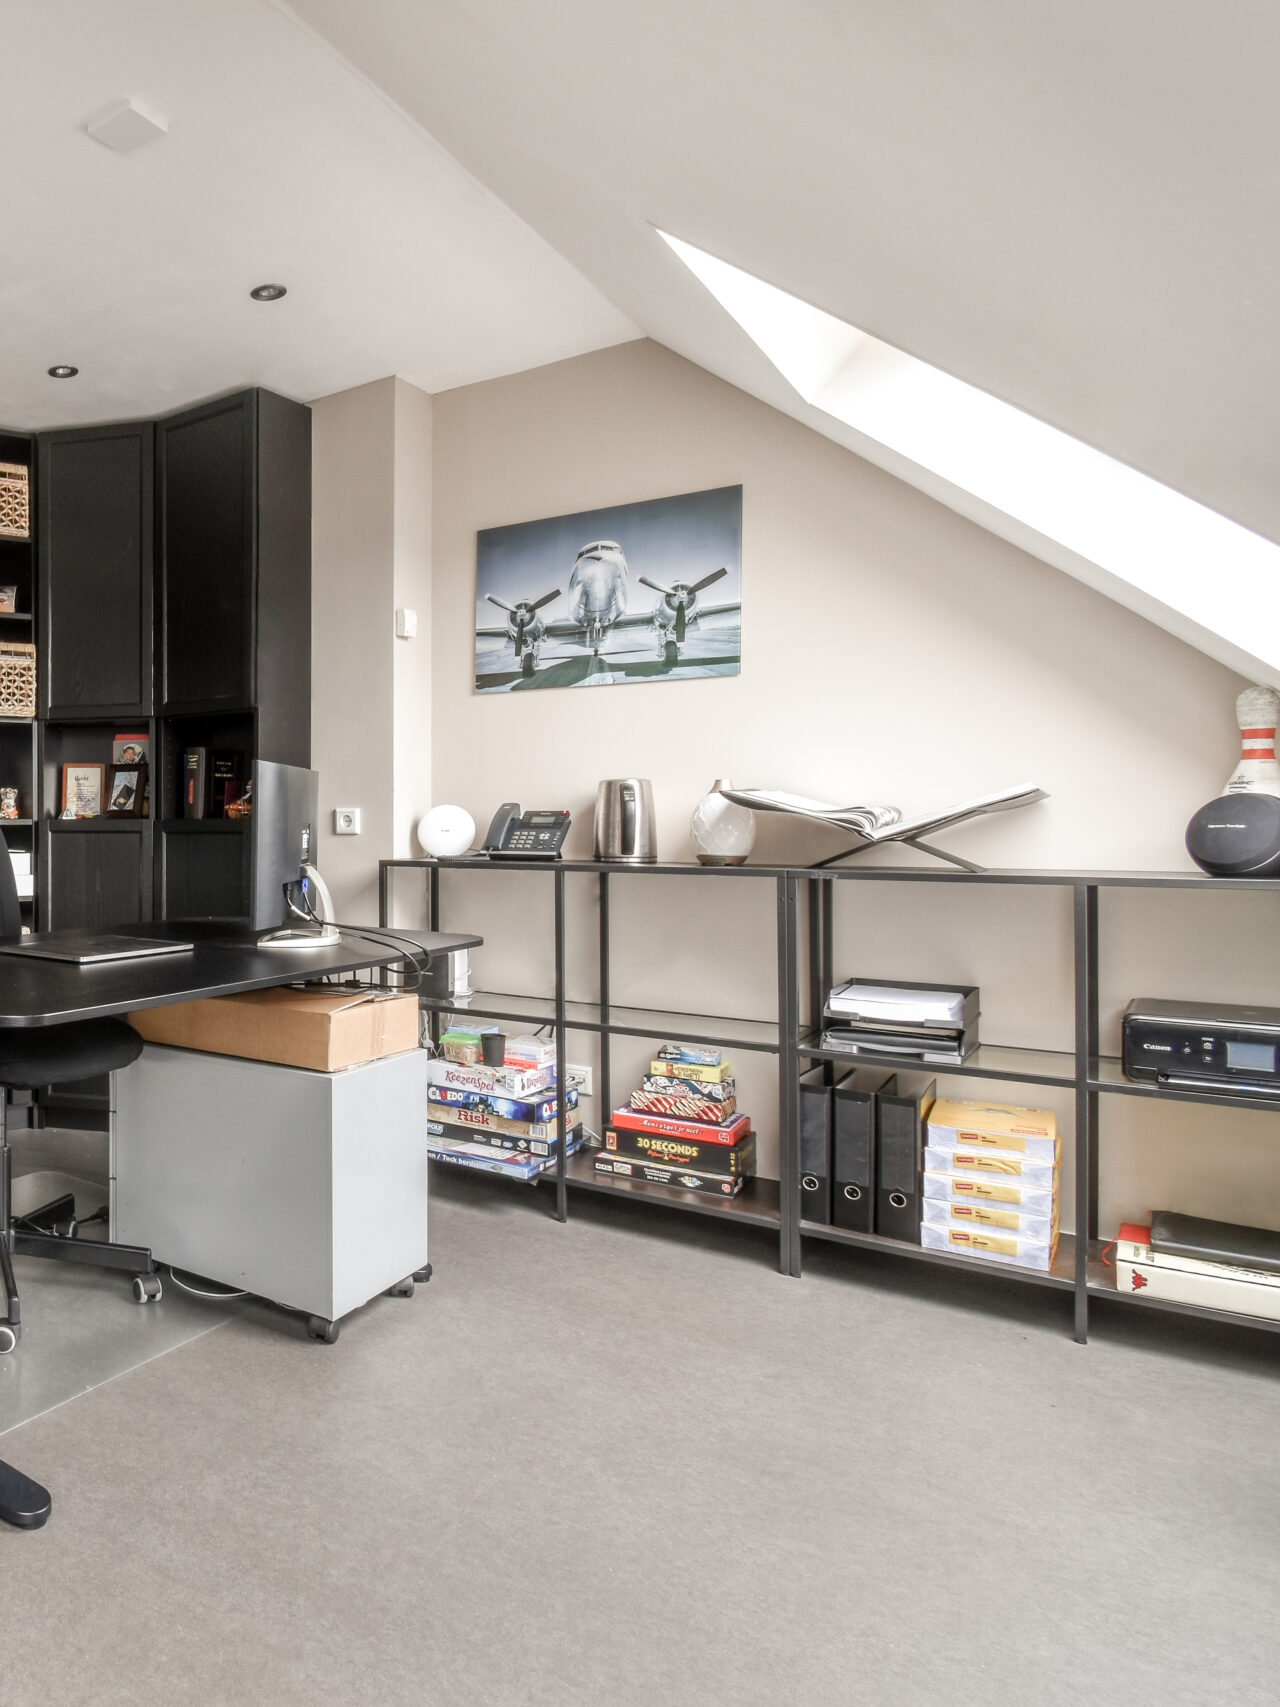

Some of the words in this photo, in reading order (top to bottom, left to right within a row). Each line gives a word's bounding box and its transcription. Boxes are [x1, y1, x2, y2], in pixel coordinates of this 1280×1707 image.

[1143, 1043, 1172, 1051] Canon
[428, 1087, 463, 1100] CLUEDO
[457, 1109, 489, 1125] Risk
[637, 1137, 650, 1148] 30
[651, 1140, 699, 1156] SECONDS
